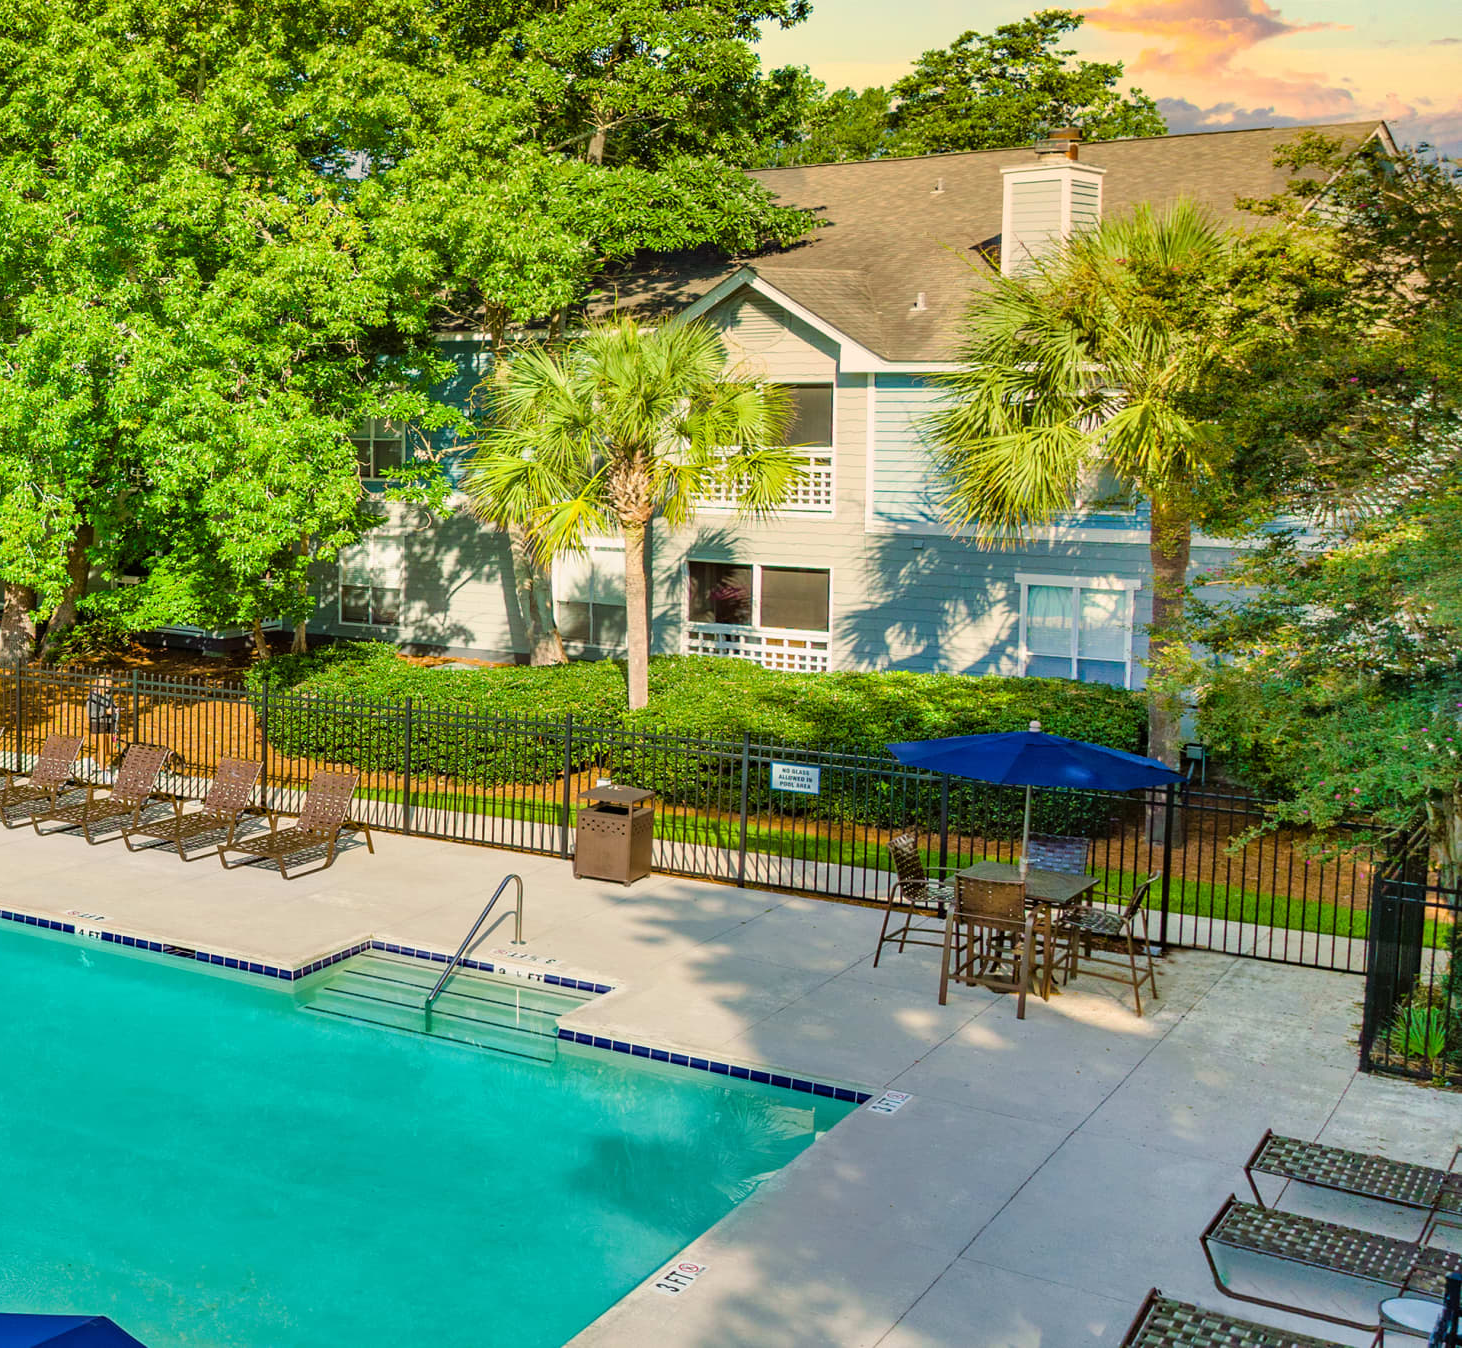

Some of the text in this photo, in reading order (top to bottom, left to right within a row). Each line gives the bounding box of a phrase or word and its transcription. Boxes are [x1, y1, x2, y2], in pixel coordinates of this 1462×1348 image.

[88, 930, 100, 939] FT
[878, 1097, 901, 1108] FT
[664, 1270, 694, 1286] FT
[655, 1283, 680, 1293] 3
